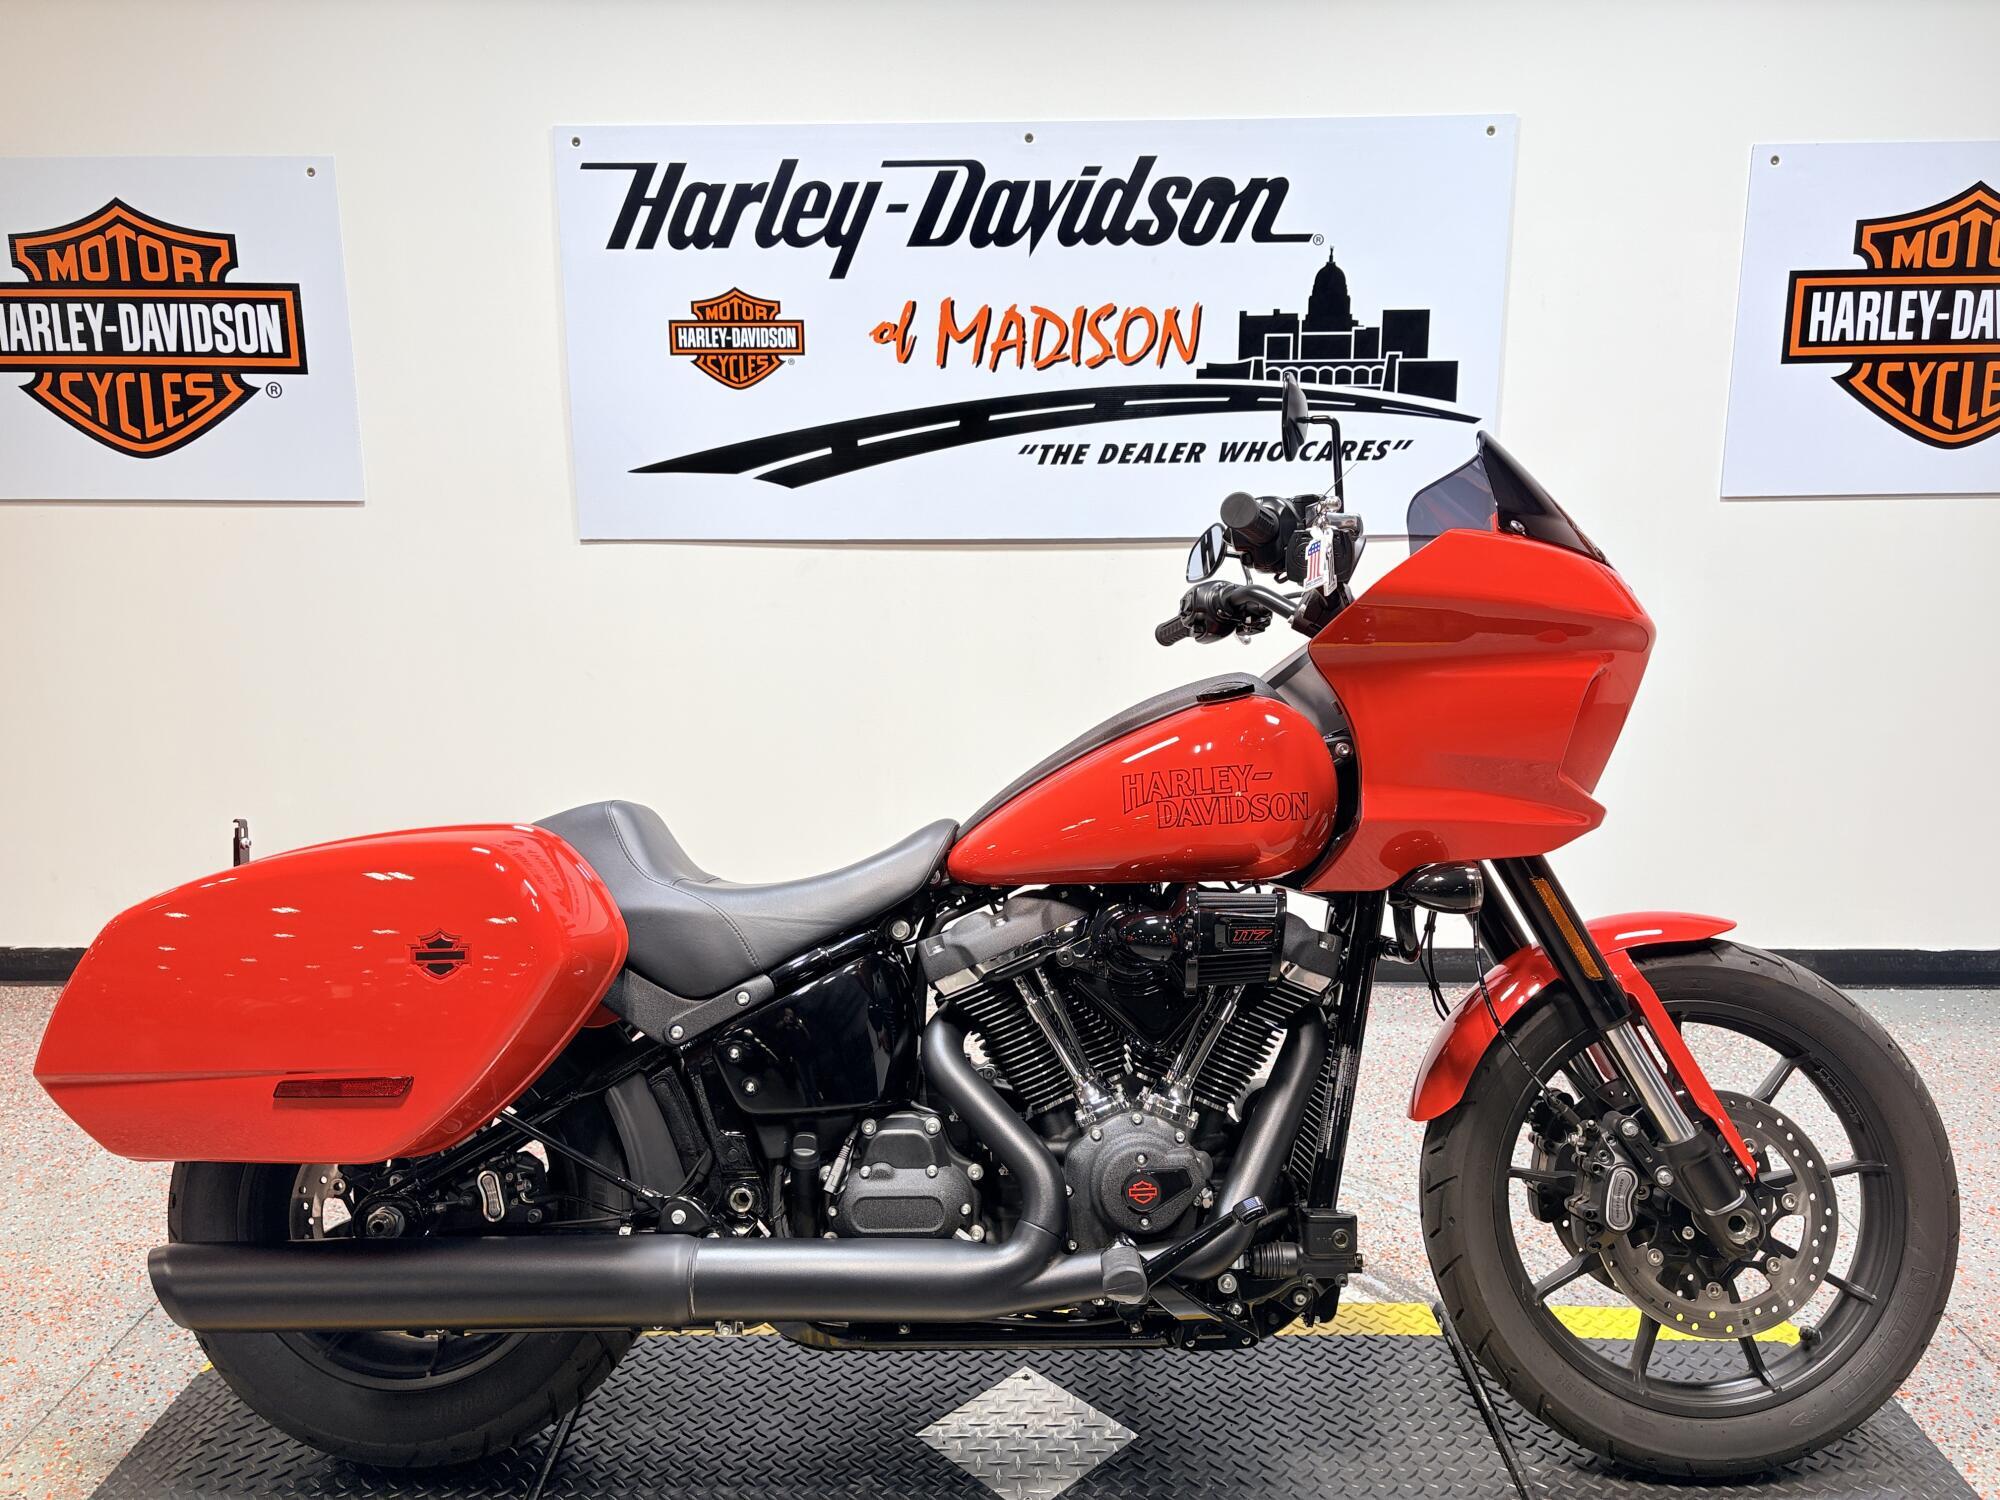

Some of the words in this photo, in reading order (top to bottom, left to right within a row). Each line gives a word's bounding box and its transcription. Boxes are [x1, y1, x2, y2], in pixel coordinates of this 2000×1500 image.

[580, 156, 1313, 279] Harley-Davidson
[47, 223, 204, 283] MOTOR
[705, 299, 768, 320] MOTOR
[869, 300, 917, 364] of
[936, 297, 1203, 373] MADISON
[1808, 289, 2000, 342] HARLEY-DA
[677, 327, 797, 348] HARLEY-DAVIDSON
[706, 355, 769, 383] CYCLES
[59, 372, 215, 439] CYCLES
[1097, 442, 1207, 464] DEALER
[1218, 441, 1288, 463] WHO
[1121, 763, 1273, 815] HARLEY-
[1157, 791, 1310, 829] DAVIDSON
